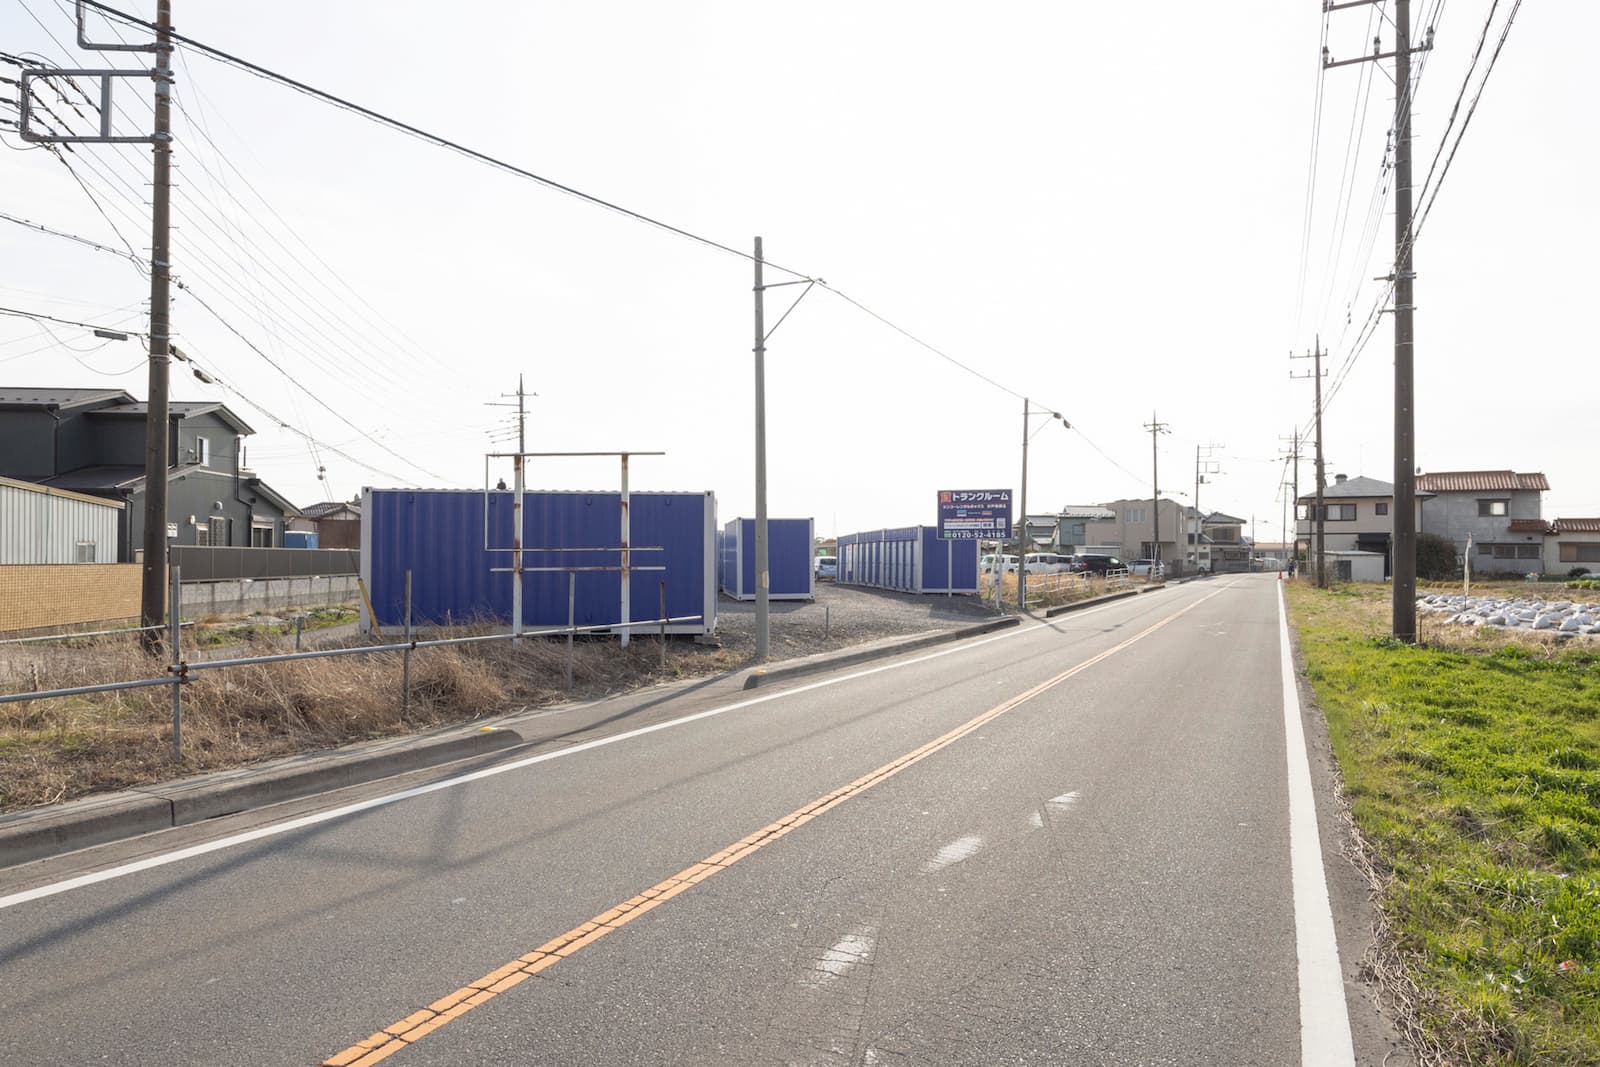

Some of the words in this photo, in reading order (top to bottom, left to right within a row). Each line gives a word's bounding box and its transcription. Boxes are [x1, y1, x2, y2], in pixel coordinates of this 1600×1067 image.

[952, 492, 1008, 502] トランクルーム
